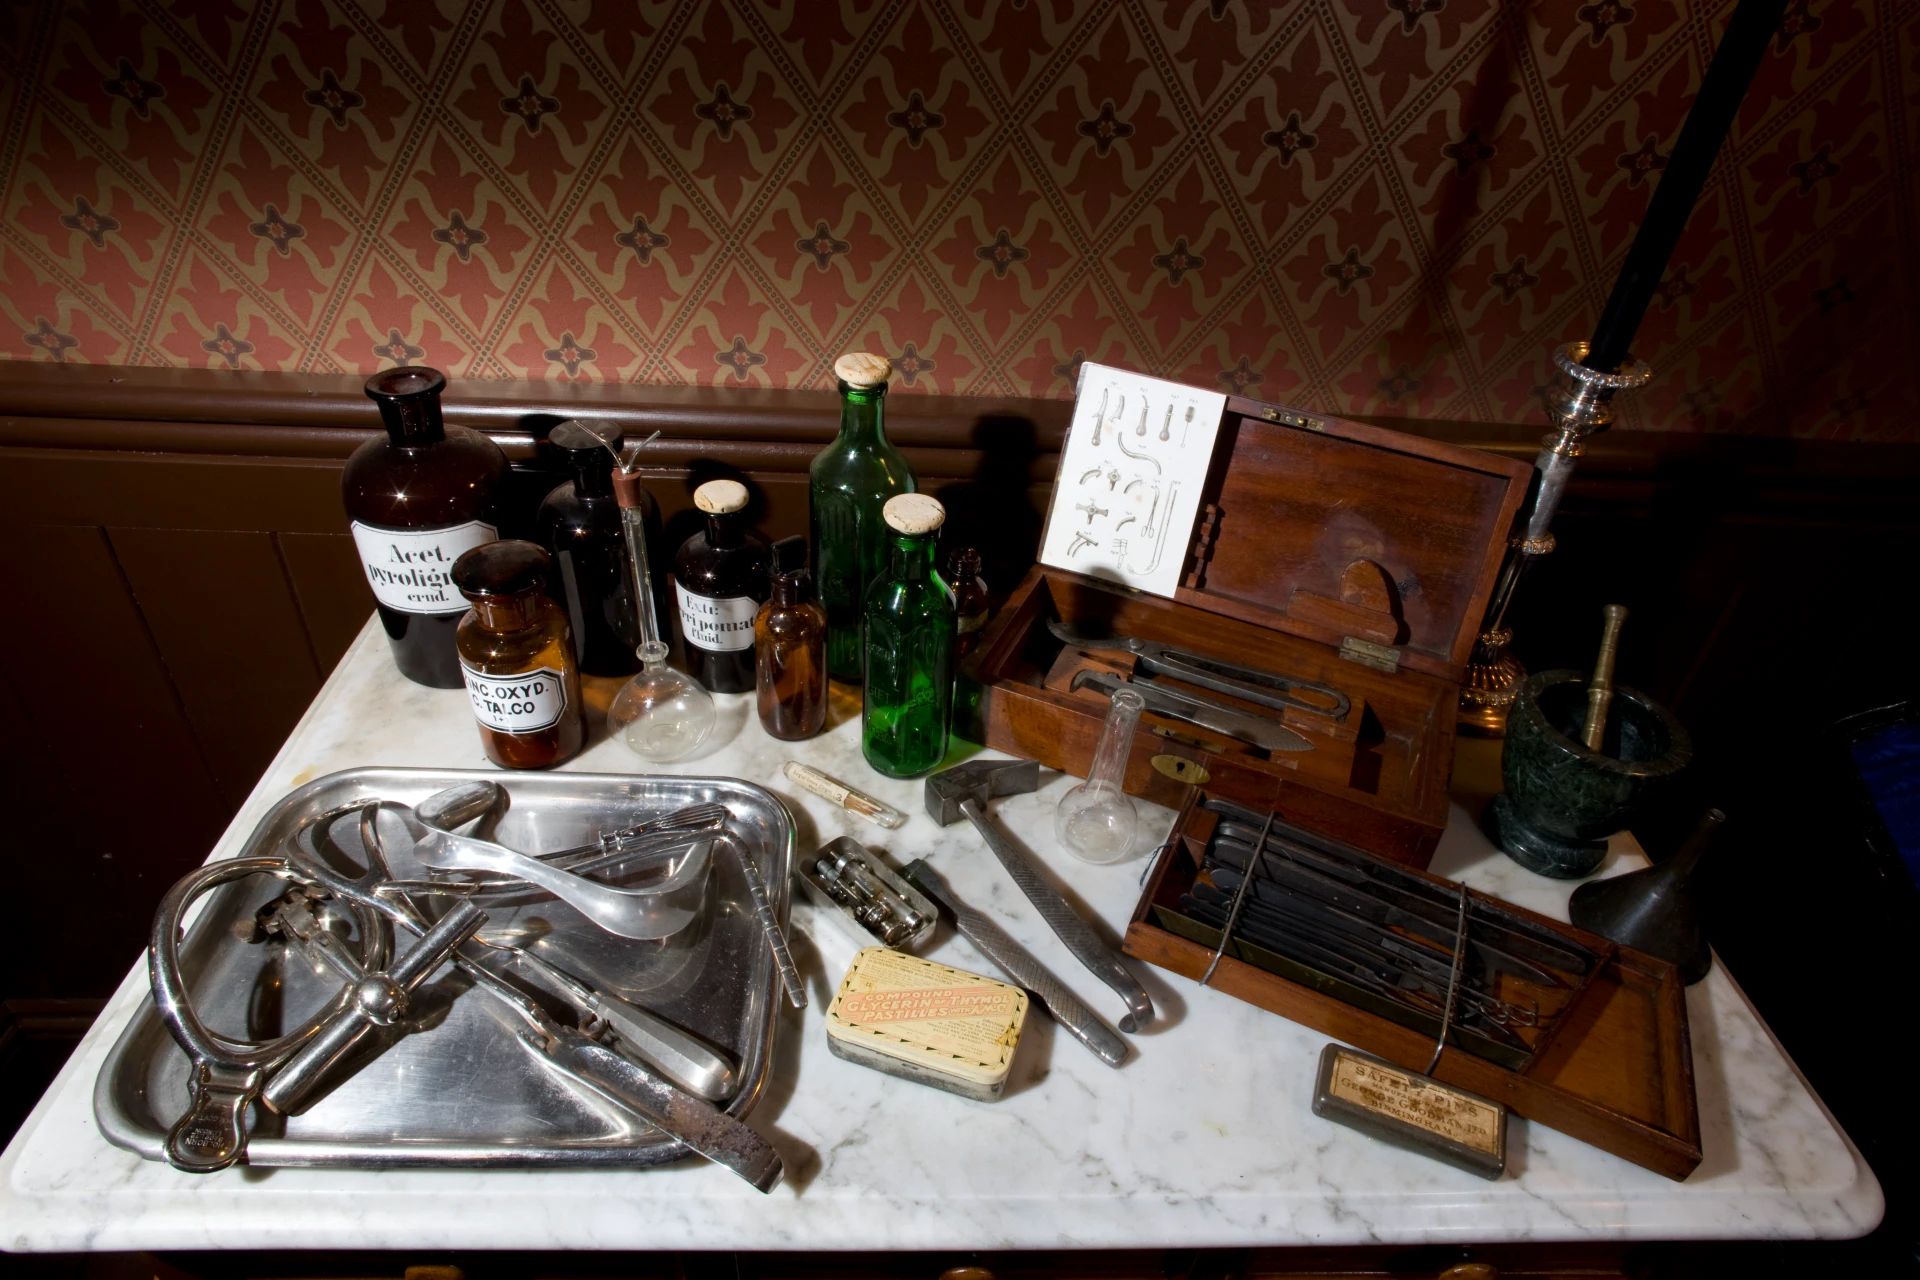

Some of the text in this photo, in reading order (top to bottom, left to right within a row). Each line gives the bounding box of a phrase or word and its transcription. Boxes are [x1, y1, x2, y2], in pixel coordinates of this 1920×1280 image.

[390, 544, 451, 564] Acet.
[407, 590, 450, 602] crud.
[483, 699, 536, 715] TALCO
[846, 998, 933, 1012] GLYCERIN
[950, 994, 1009, 1006] THYMOL
[865, 990, 953, 1001] COMPOUND
[863, 1007, 949, 1021] PASTILLES
